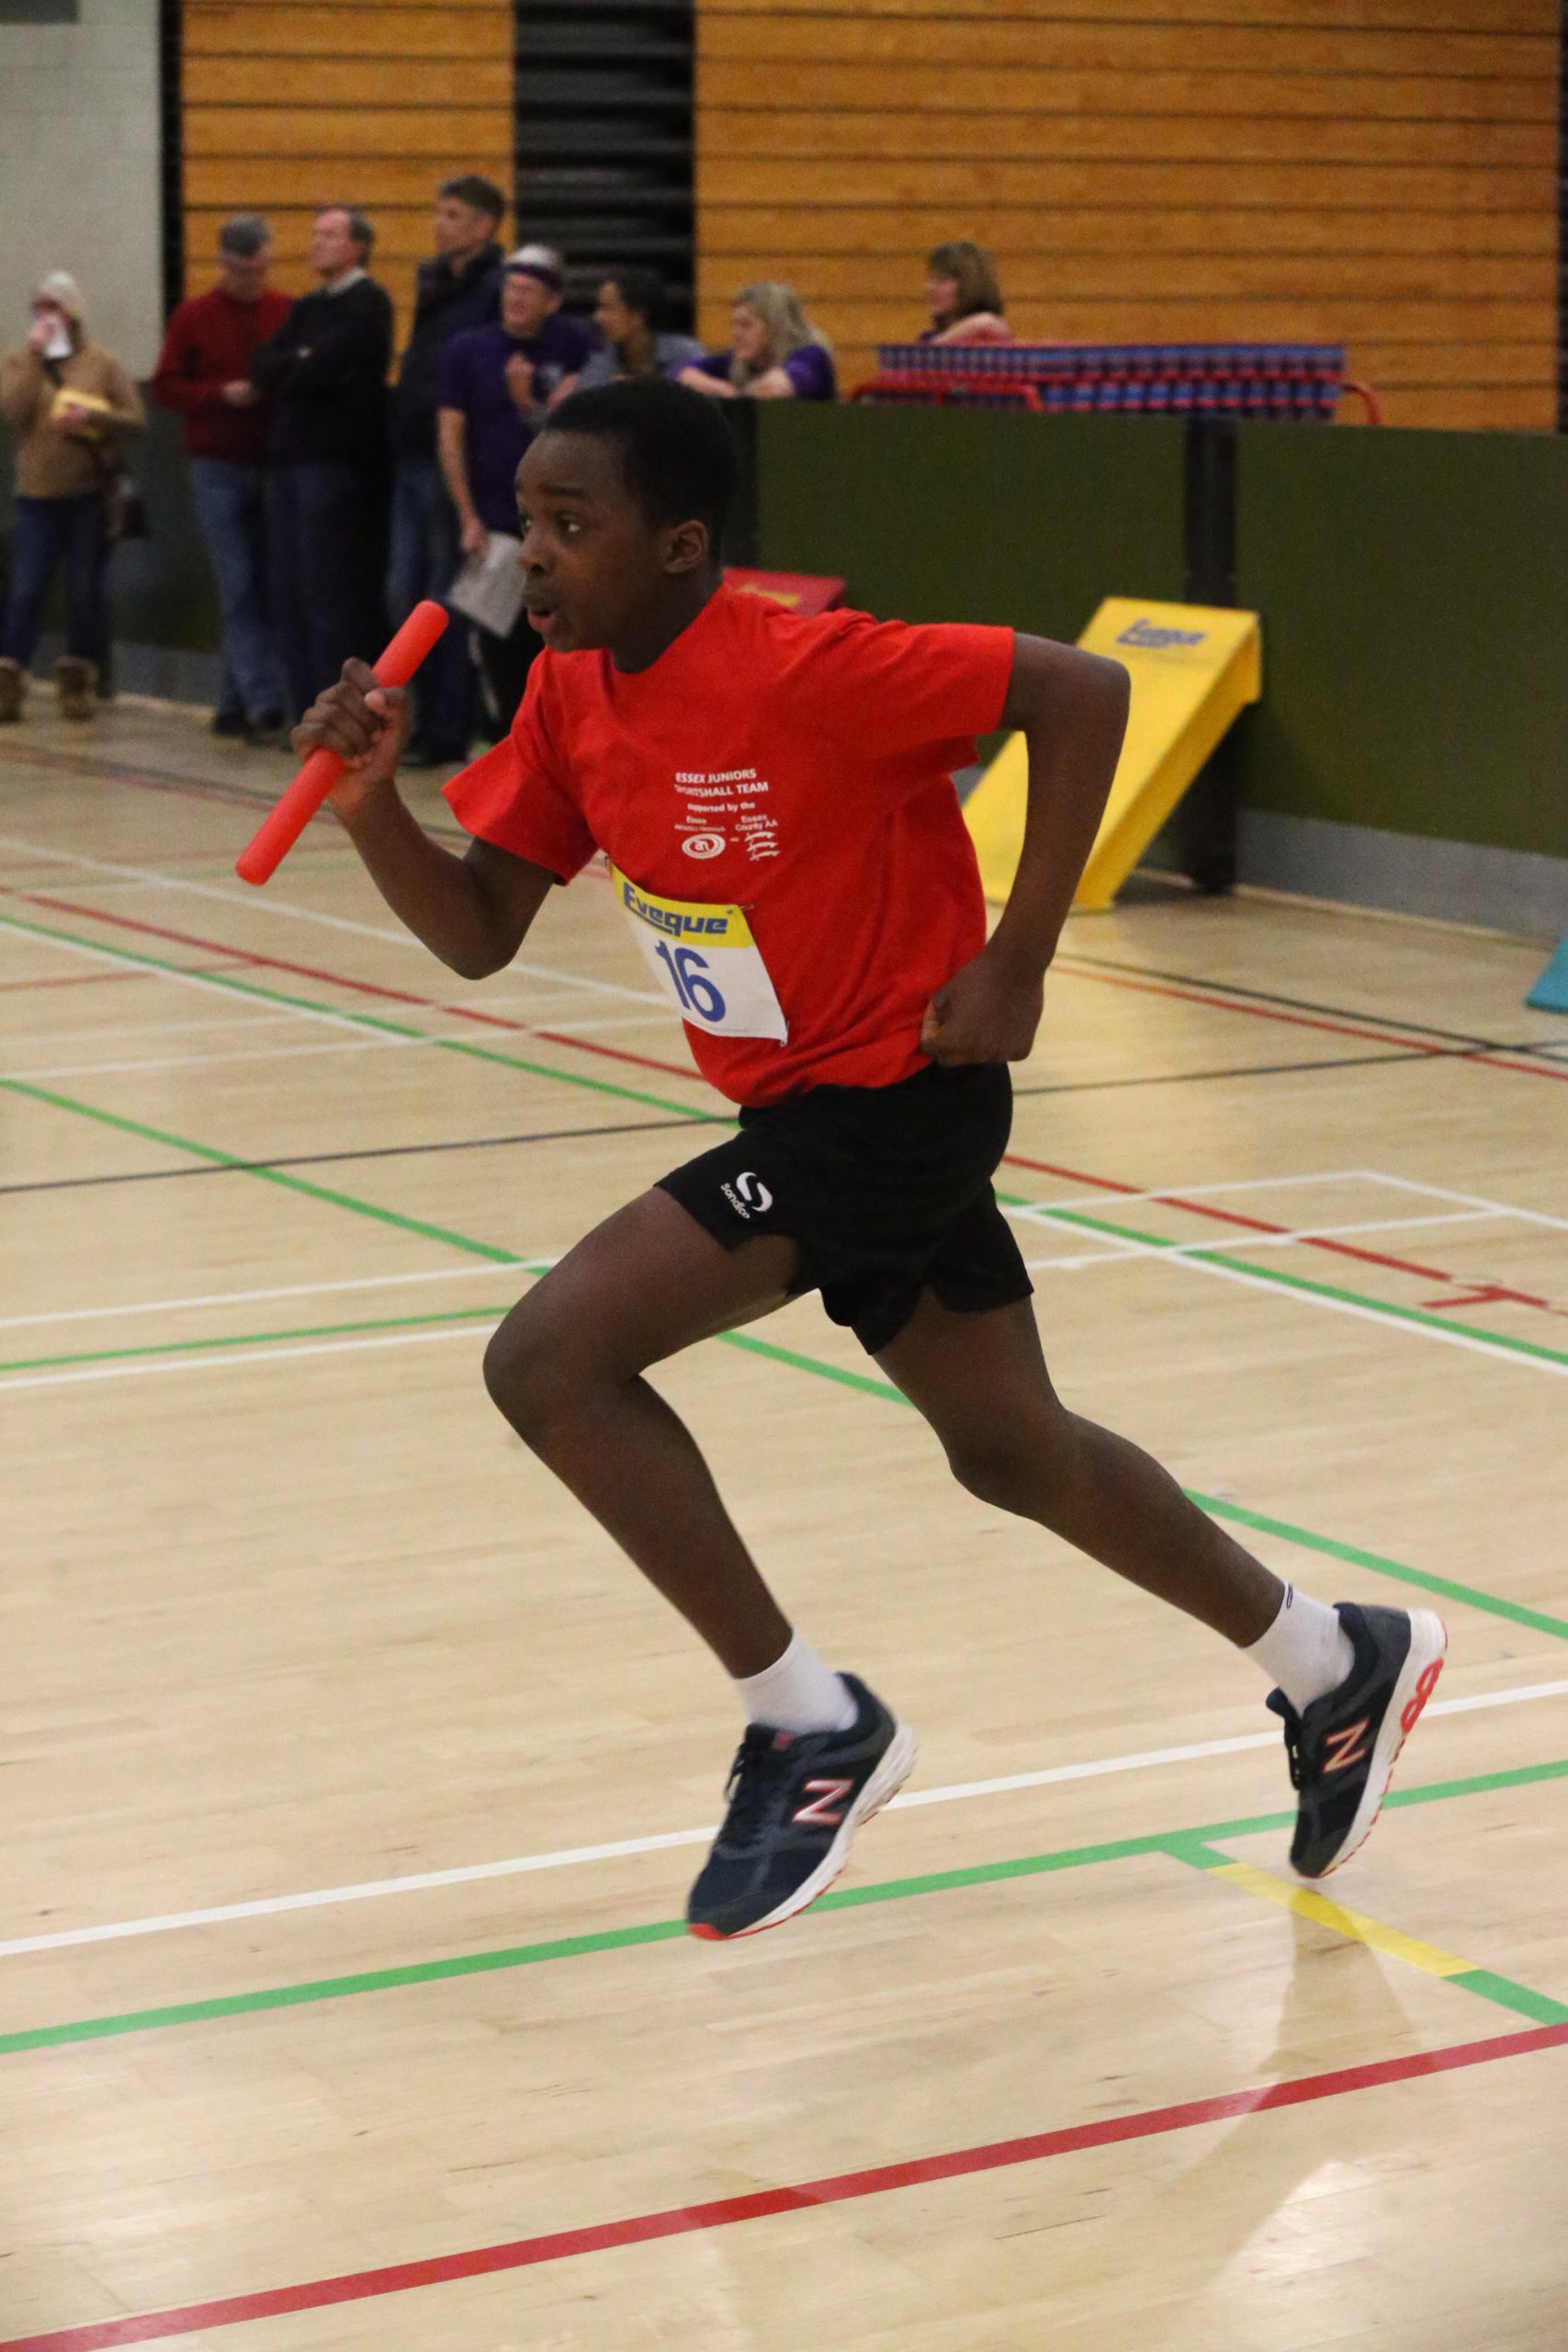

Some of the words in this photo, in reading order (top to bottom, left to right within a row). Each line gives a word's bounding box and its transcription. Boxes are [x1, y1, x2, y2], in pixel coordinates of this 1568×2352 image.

[675, 772, 705, 783] ESSEX
[708, 768, 757, 783] JUNIORS
[736, 782, 769, 794] TEAM
[727, 802, 738, 812] by
[740, 801, 755, 809] the
[624, 881, 728, 937] Eveque
[654, 939, 726, 1023] 16
